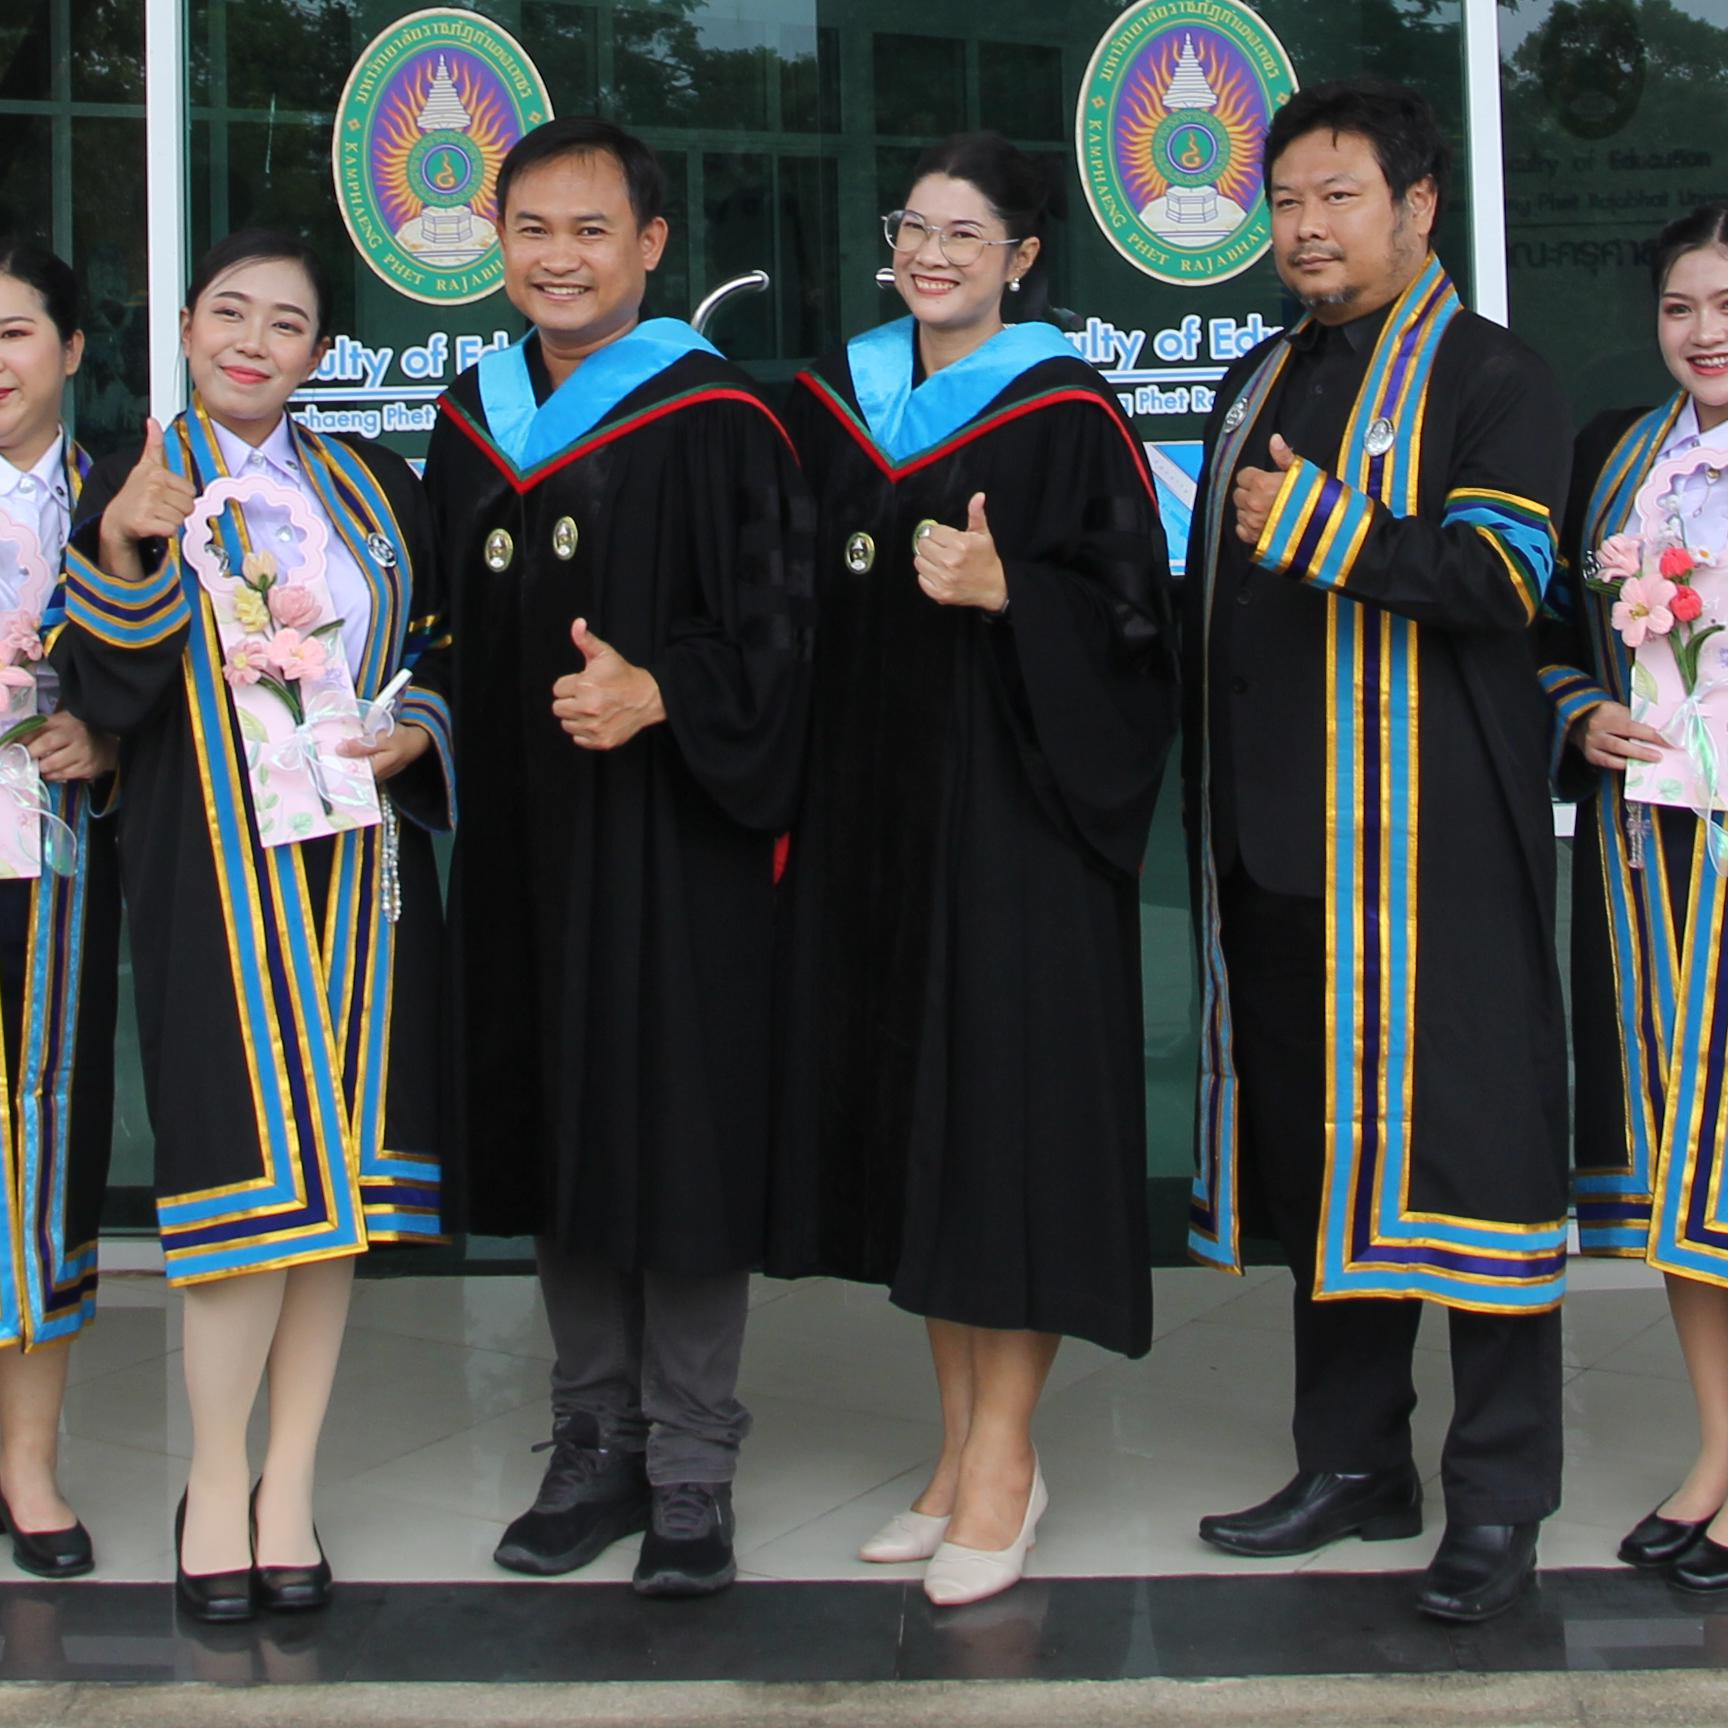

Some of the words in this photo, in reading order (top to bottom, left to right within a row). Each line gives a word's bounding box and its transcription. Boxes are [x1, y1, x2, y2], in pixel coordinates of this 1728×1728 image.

[345, 141, 383, 250] KAMPHAENG
[383, 253, 425, 287] PHET
[435, 259, 505, 293] RAJABH
[1088, 119, 1127, 229] KAMPHAENG
[1127, 232, 1170, 266] PHET
[1180, 221, 1268, 274] RAJABHAT
[401, 332, 449, 379] of
[1153, 314, 1202, 362] of
[381, 401, 437, 432] Phet
[1135, 384, 1190, 415] Phet
